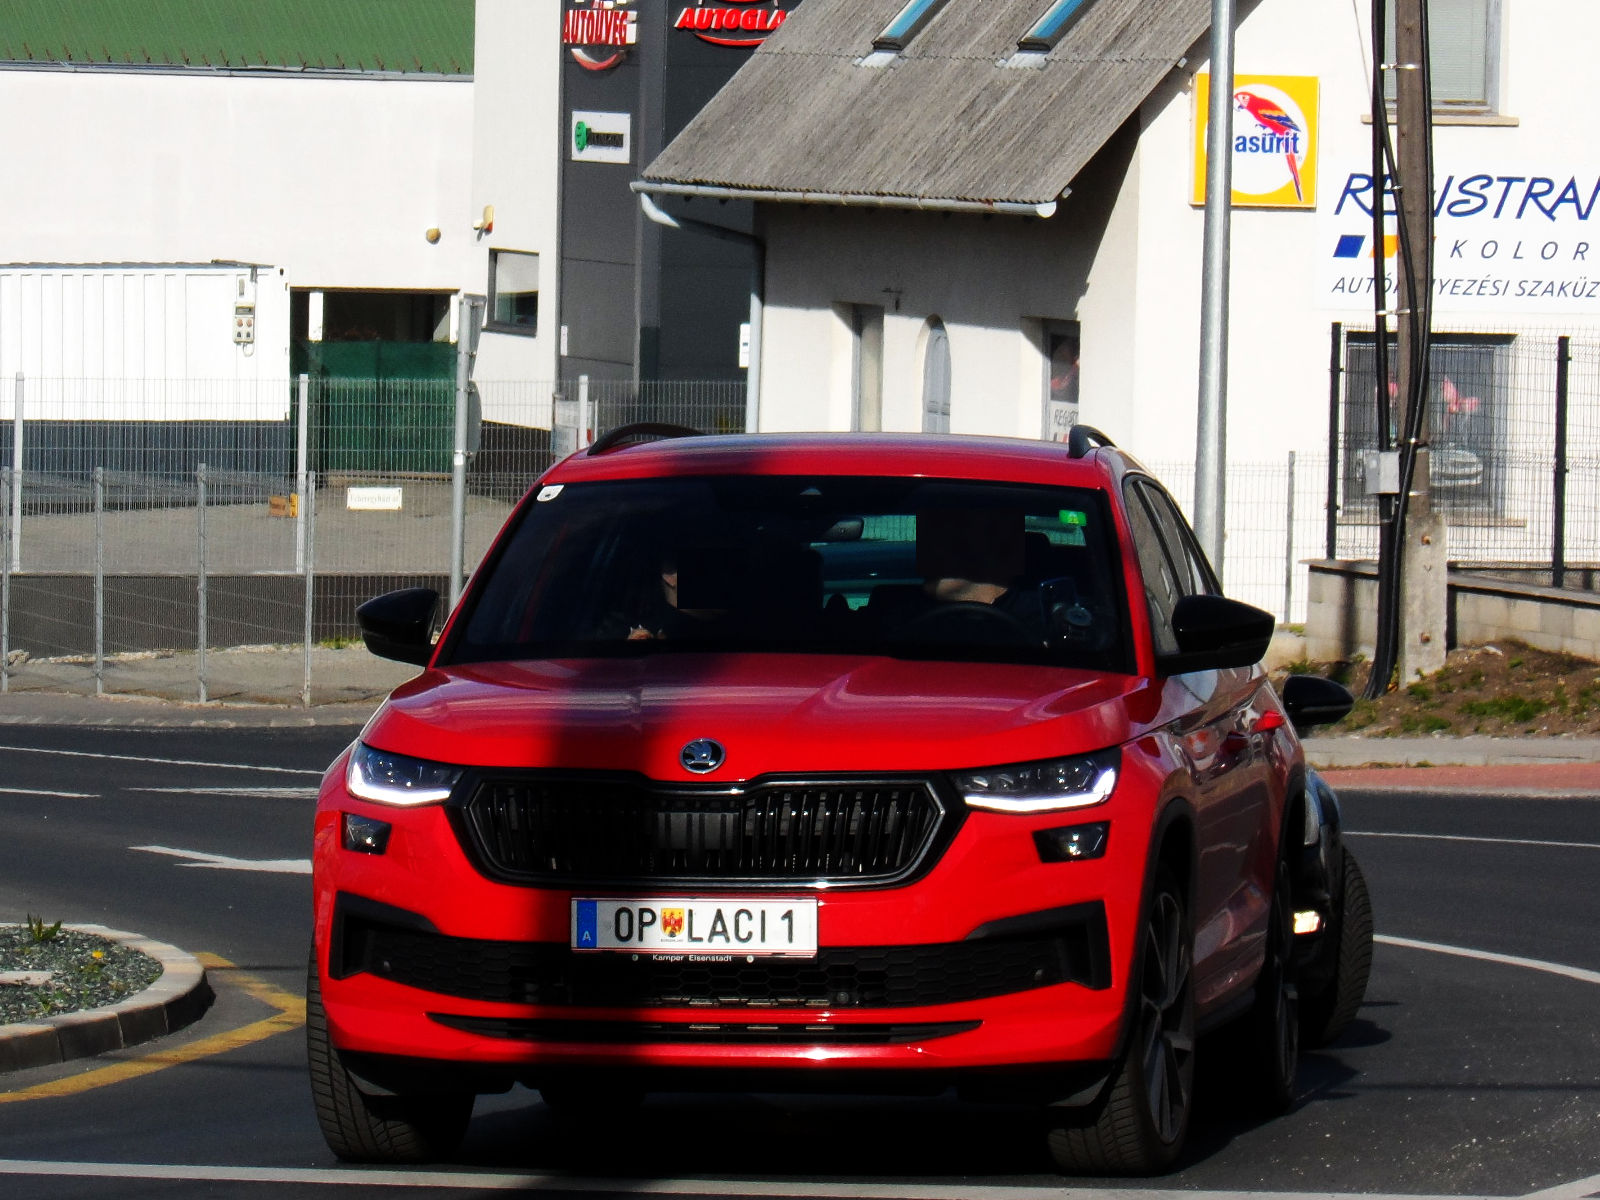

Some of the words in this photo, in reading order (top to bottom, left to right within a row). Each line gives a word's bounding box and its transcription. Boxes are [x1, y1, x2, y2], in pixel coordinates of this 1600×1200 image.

[674, 8, 788, 31] AUTOGLA
[1450, 239, 1590, 261] KOLOR
[582, 930, 592, 942] A
[614, 906, 657, 943] OP
[687, 908, 766, 944] LACI
[780, 909, 794, 944] 1
[652, 954, 684, 963] Kamper
[688, 954, 733, 963] Eisenstadt
